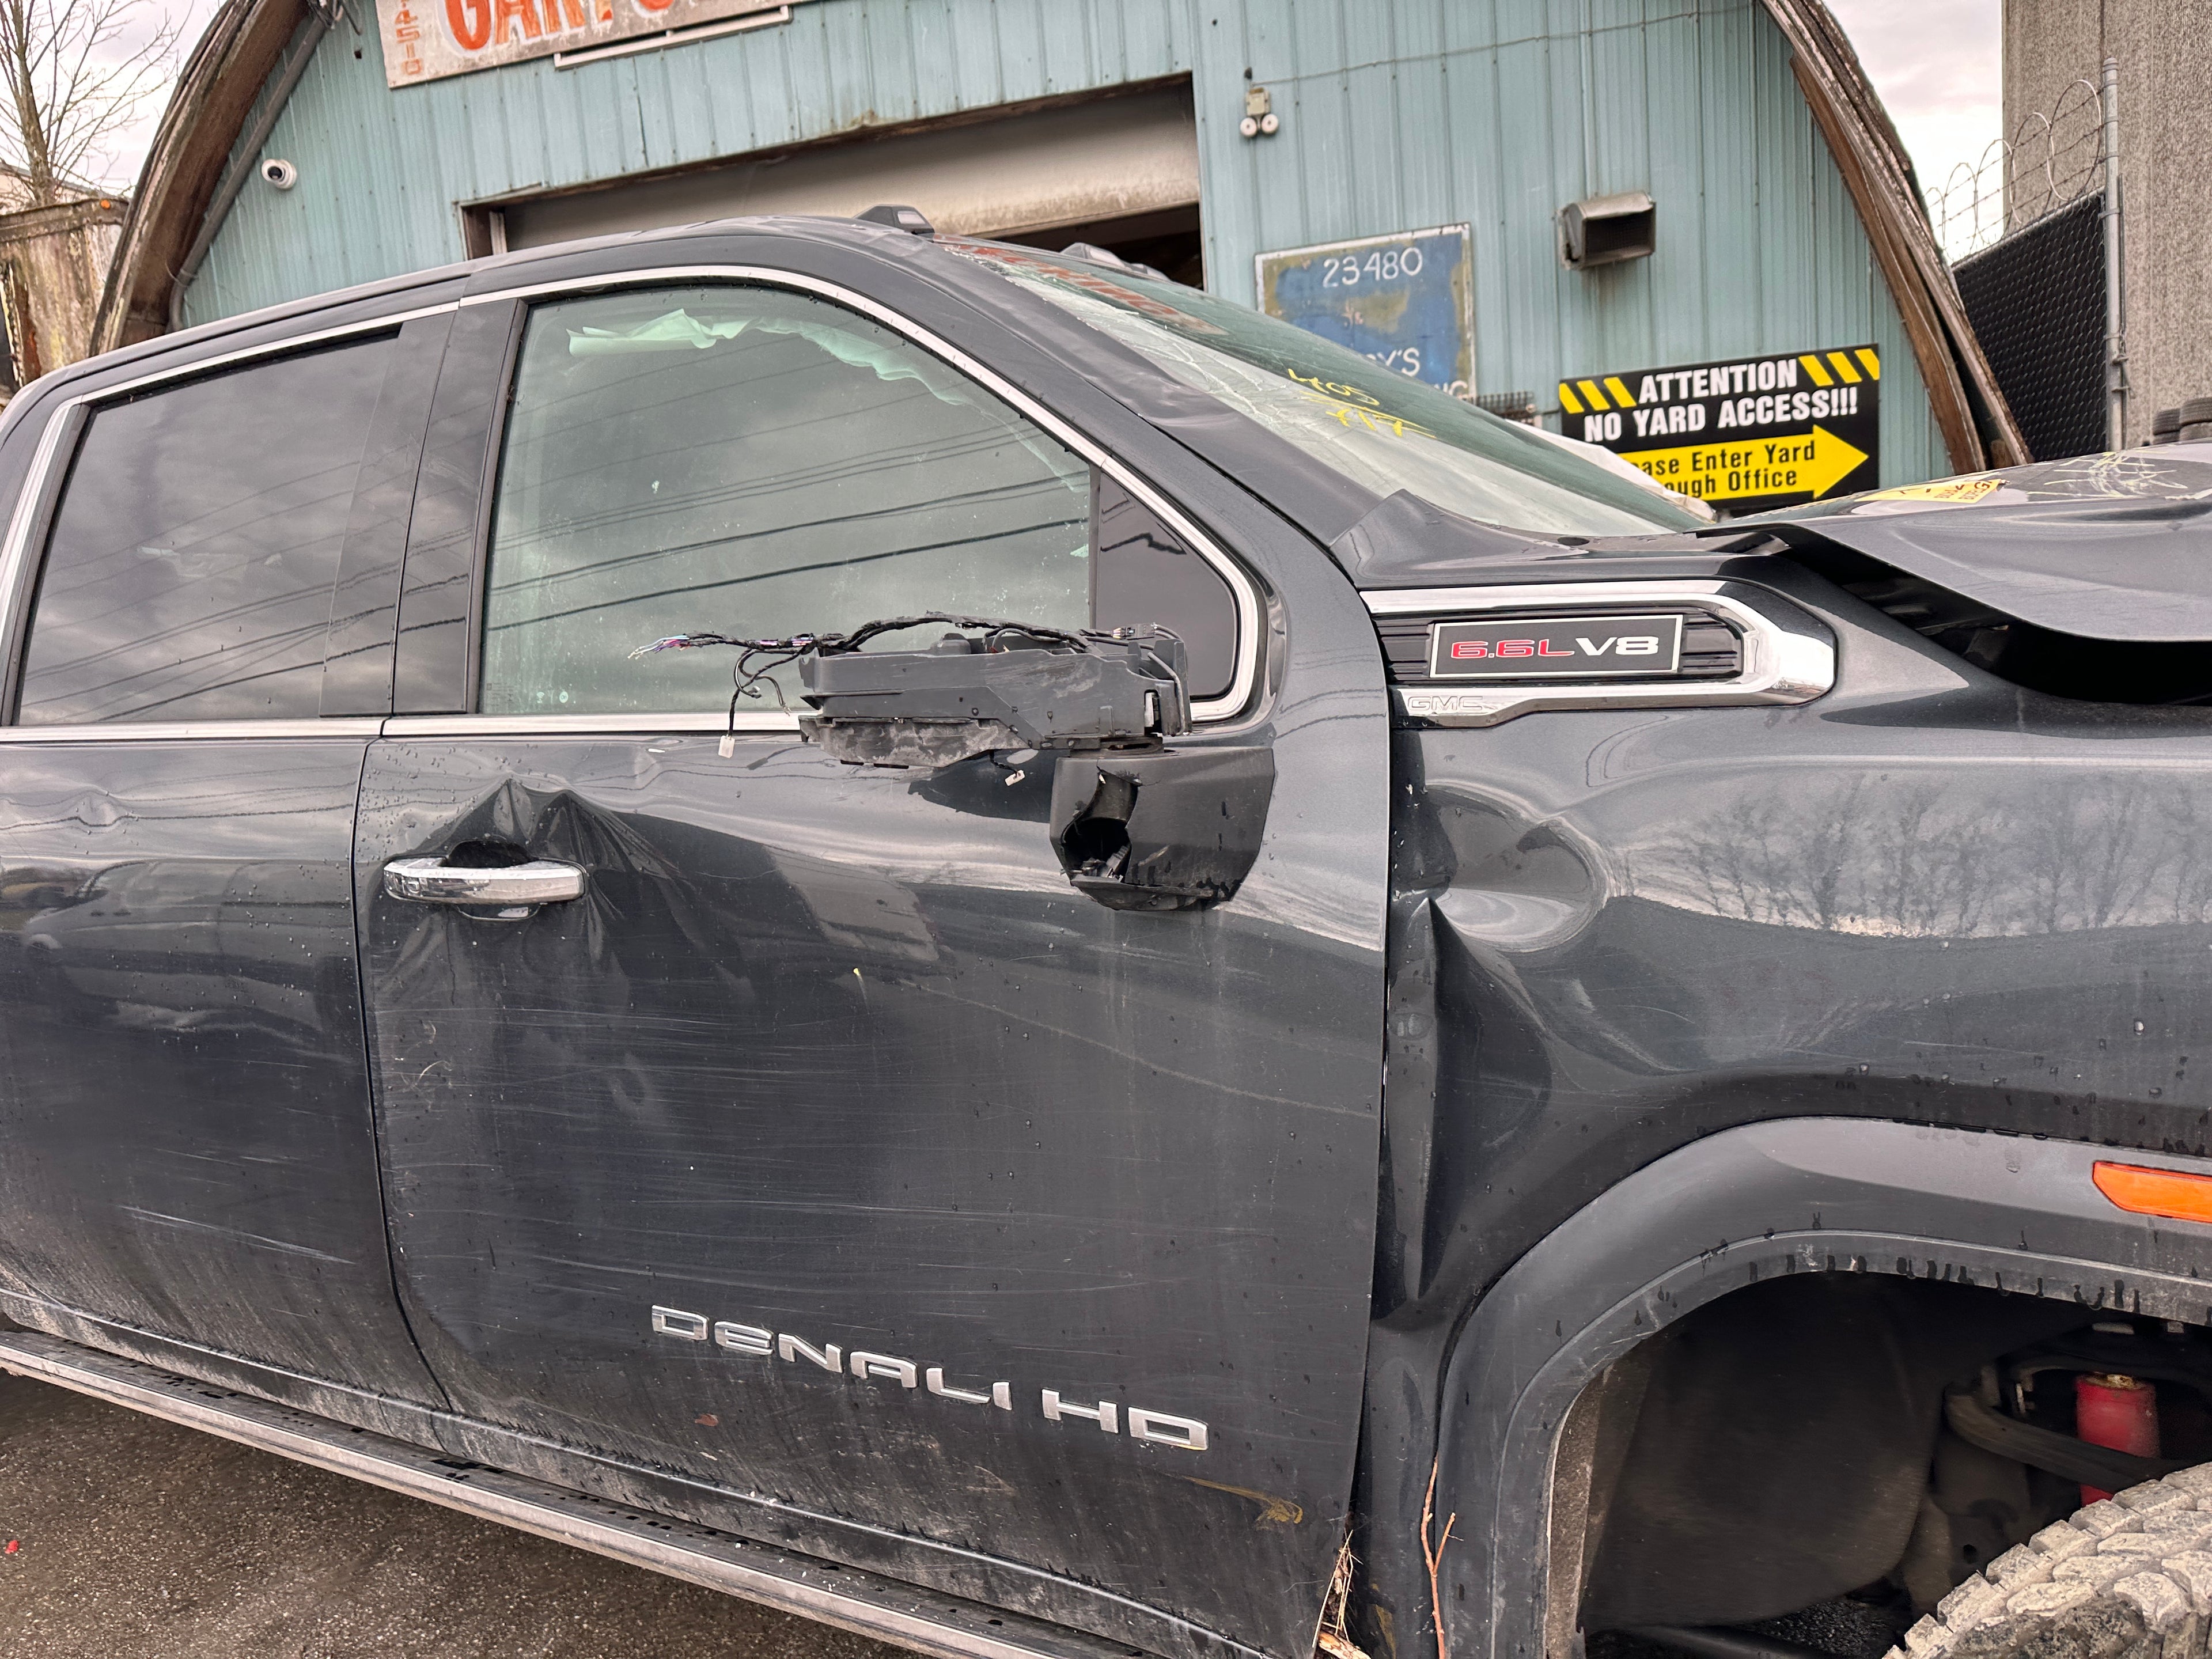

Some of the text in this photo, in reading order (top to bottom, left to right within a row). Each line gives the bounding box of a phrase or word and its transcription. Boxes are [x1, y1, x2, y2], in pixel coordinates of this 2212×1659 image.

[1323, 247, 1423, 287] 23480
[1366, 347, 1421, 377] Y'S
[1639, 359, 1797, 404] ATTENTION
[1584, 386, 1858, 442] NO YARD ACCESS!!!
[1631, 440, 1816, 477] ase Enter Yard
[1728, 469, 1798, 491] Office
[1407, 695, 1483, 712] GMC
[652, 1304, 1210, 1452] DENALI HD
